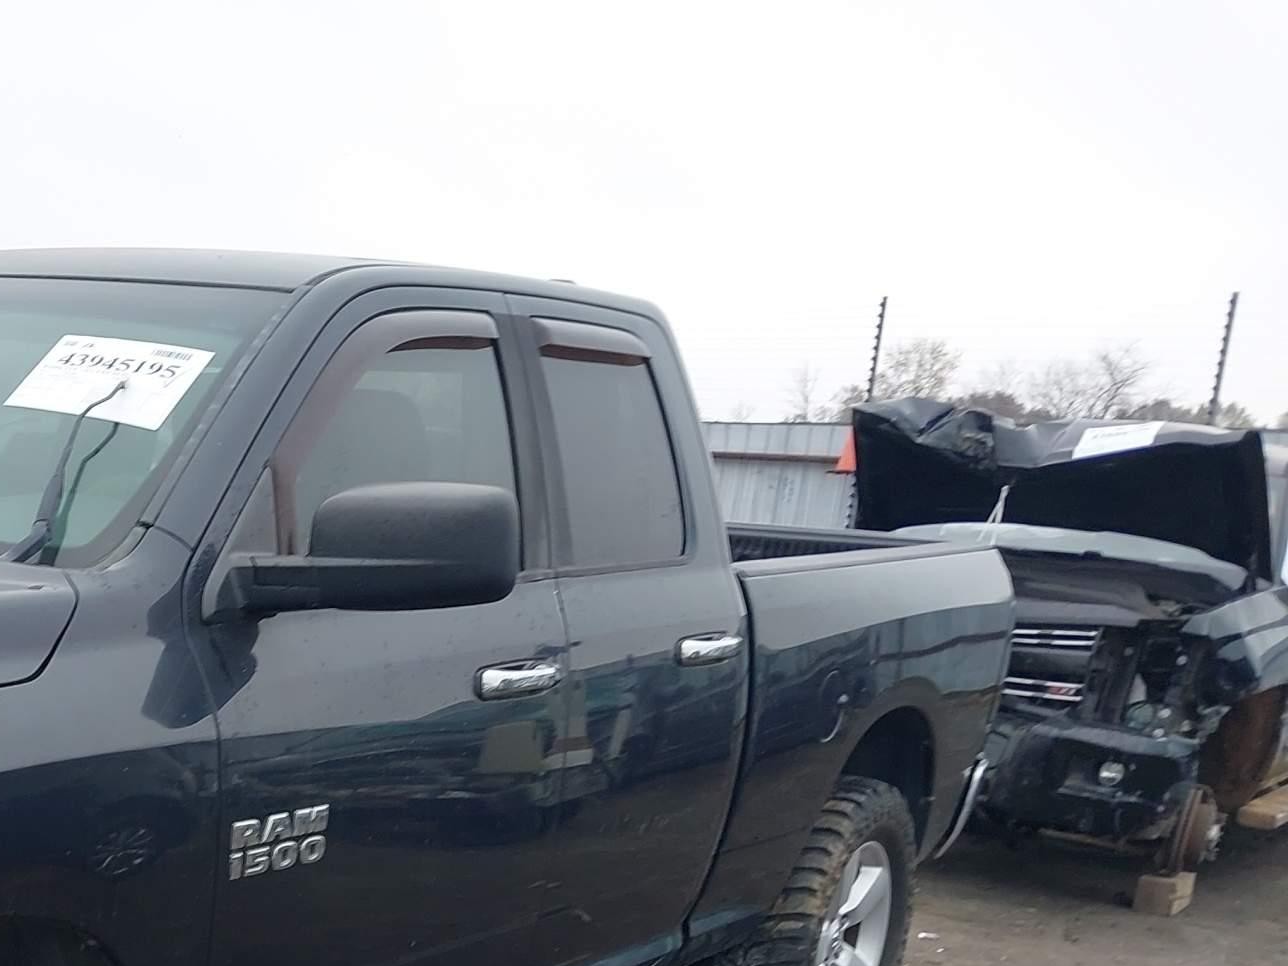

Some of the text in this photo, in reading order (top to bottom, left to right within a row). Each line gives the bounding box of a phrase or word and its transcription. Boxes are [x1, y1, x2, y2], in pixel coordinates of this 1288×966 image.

[58, 352, 181, 379] 43945195
[230, 803, 330, 850] RAM
[229, 835, 326, 881] 1500
